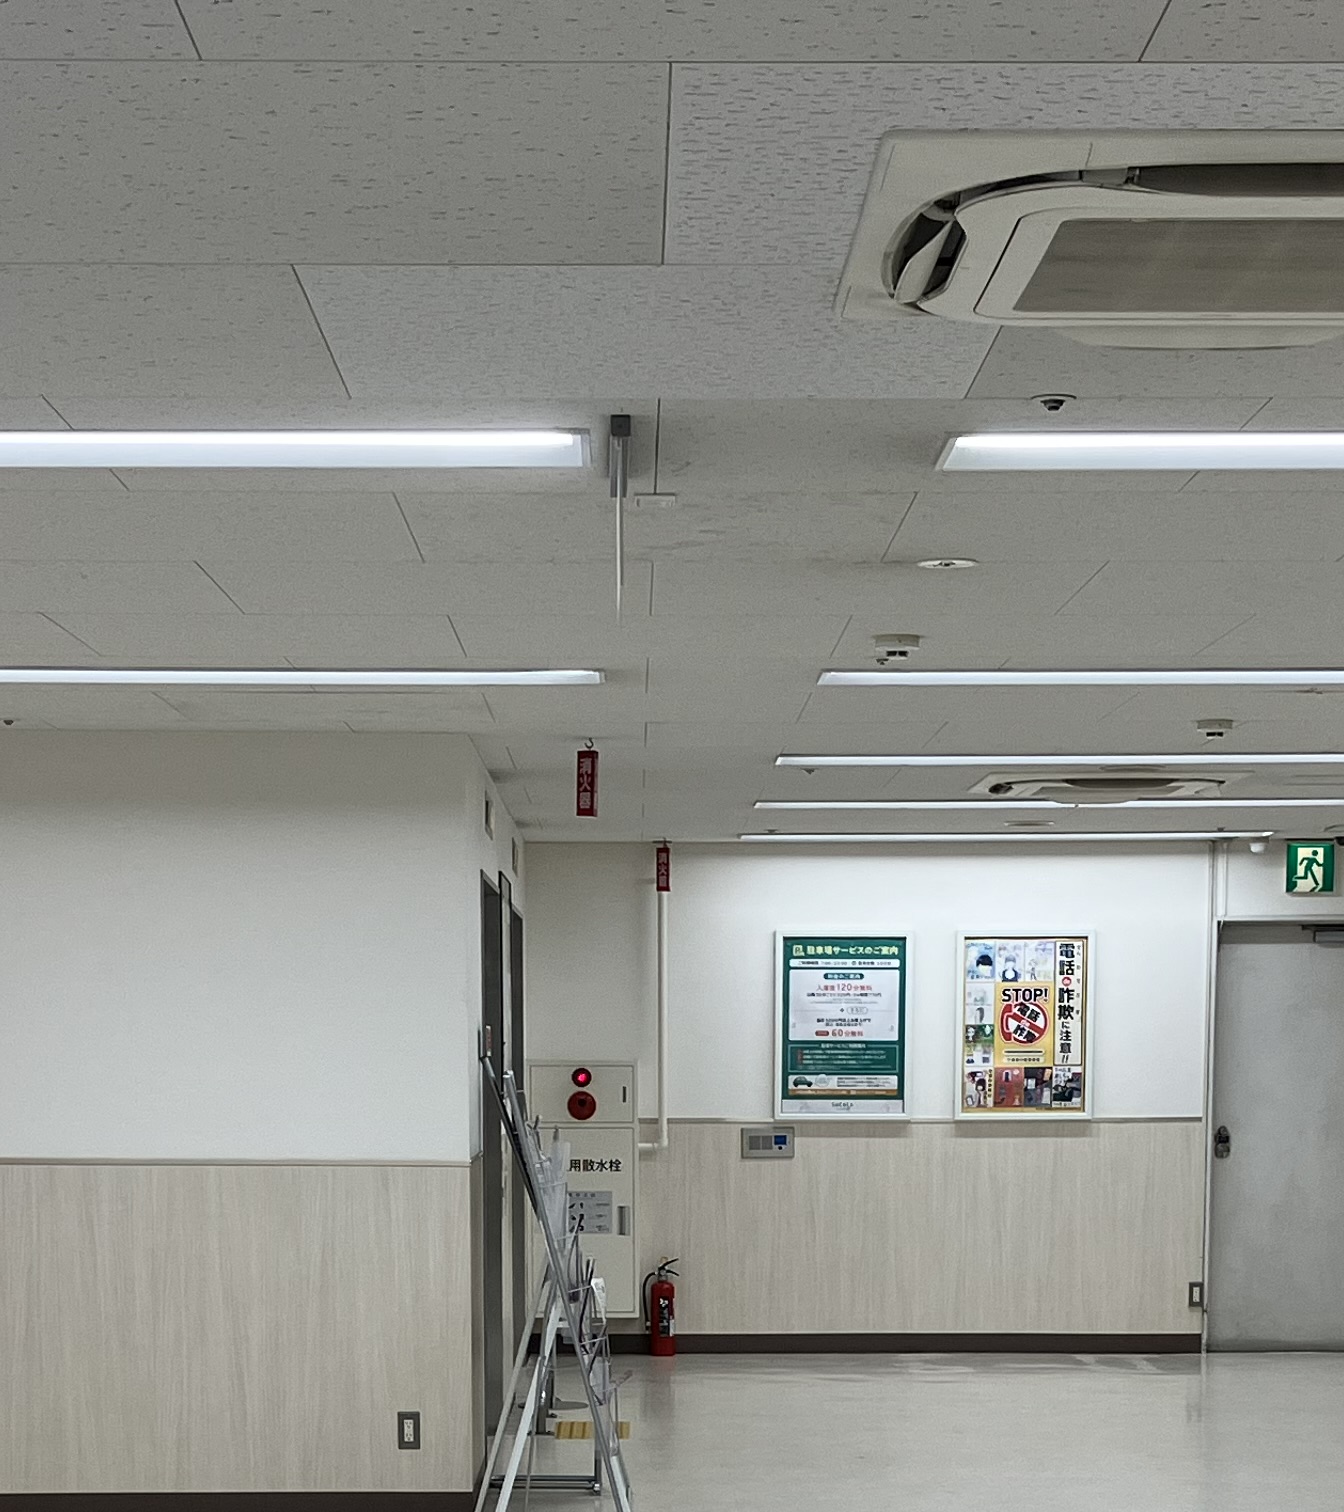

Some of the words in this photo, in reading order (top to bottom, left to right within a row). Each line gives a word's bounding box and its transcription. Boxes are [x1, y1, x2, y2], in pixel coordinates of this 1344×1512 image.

[579, 757, 592, 809] 消火器
[1002, 988, 1048, 1003] STOP!
[568, 1158, 622, 1172] 用散水栓
